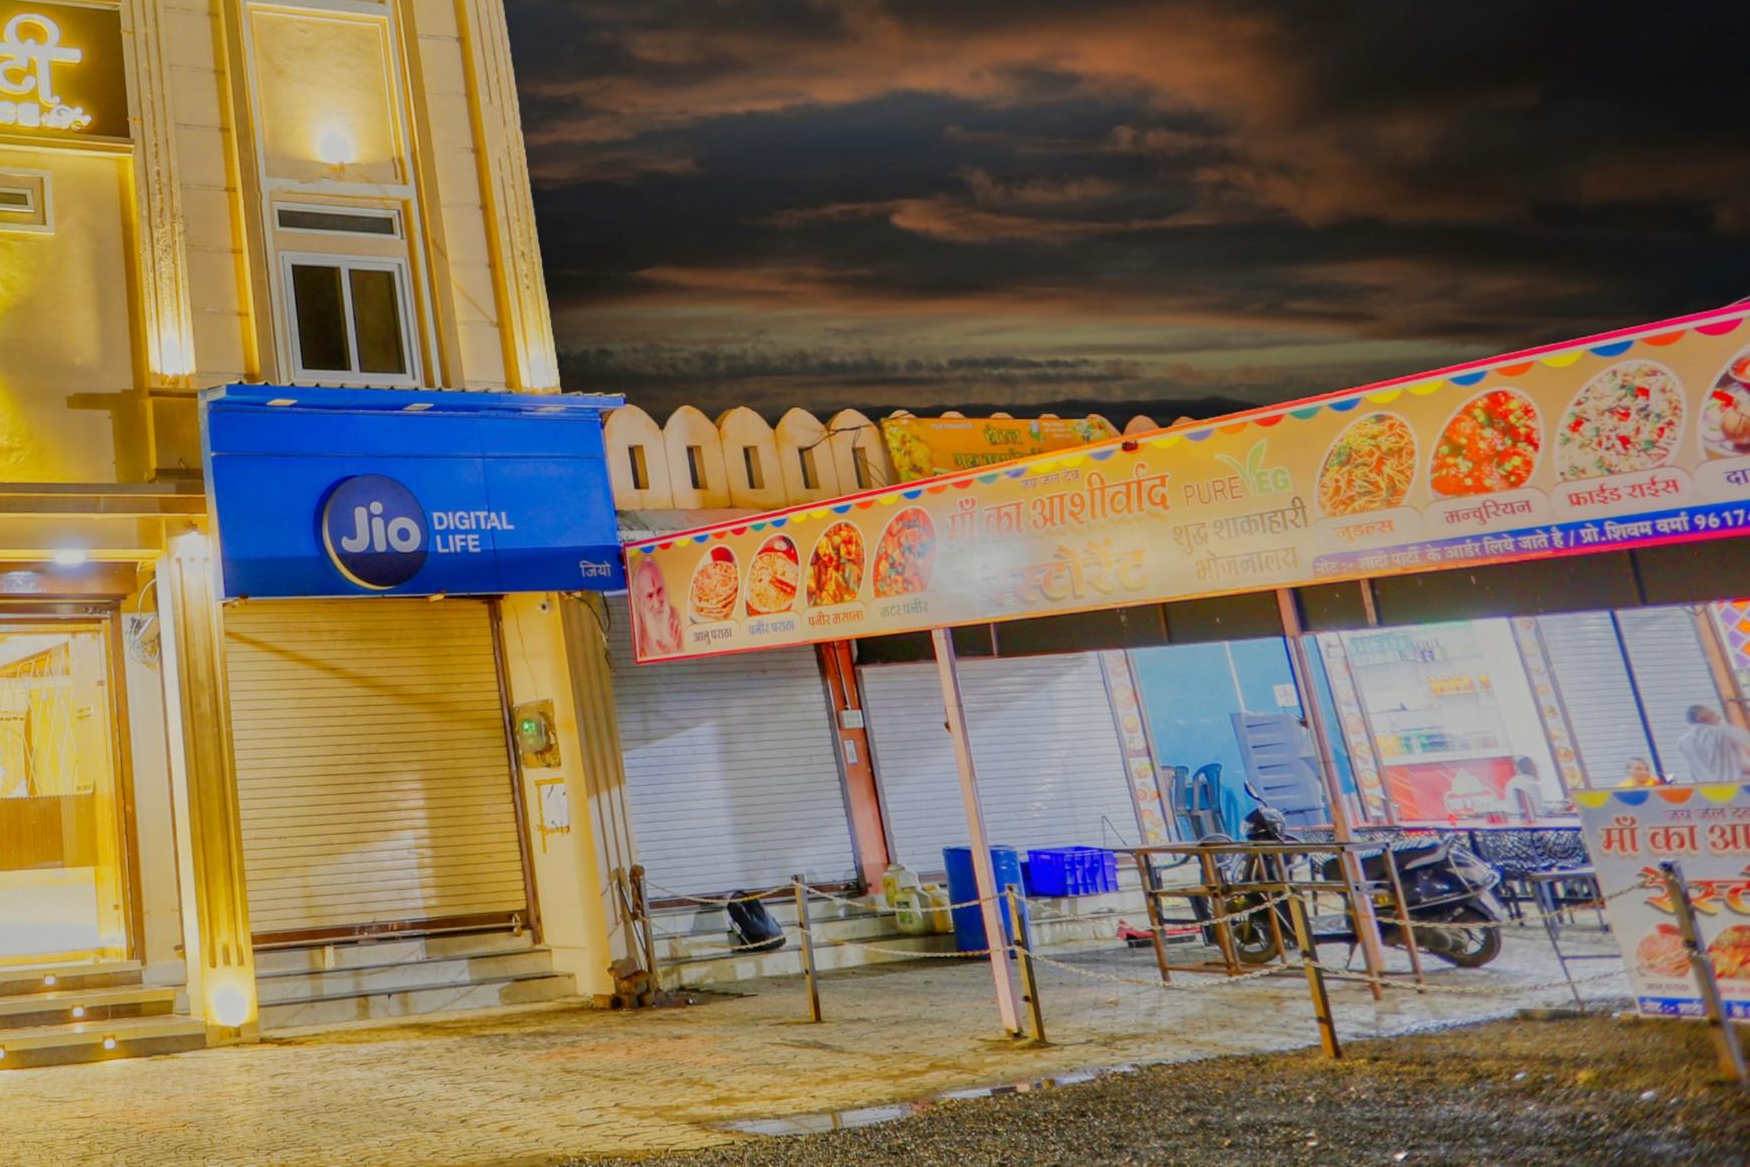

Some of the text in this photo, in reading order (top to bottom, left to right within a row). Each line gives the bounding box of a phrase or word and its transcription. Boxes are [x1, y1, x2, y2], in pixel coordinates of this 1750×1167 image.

[985, 501, 1024, 534] का
[1031, 463, 1171, 530] आशीर्वाद
[1183, 475, 1244, 507] PURE
[1625, 475, 1680, 499] राईस
[341, 501, 421, 553] Jio
[433, 511, 515, 531] DIGITAL
[1213, 496, 1309, 541] शाकाहारी
[436, 534, 481, 553] LIFE
[1518, 528, 1549, 550] जाते
[579, 560, 611, 578] जियो
[1195, 546, 1298, 580] भोजनालय
[808, 615, 831, 627] पनीर
[1601, 816, 1639, 853] माँ
[1649, 825, 1698, 853] का
